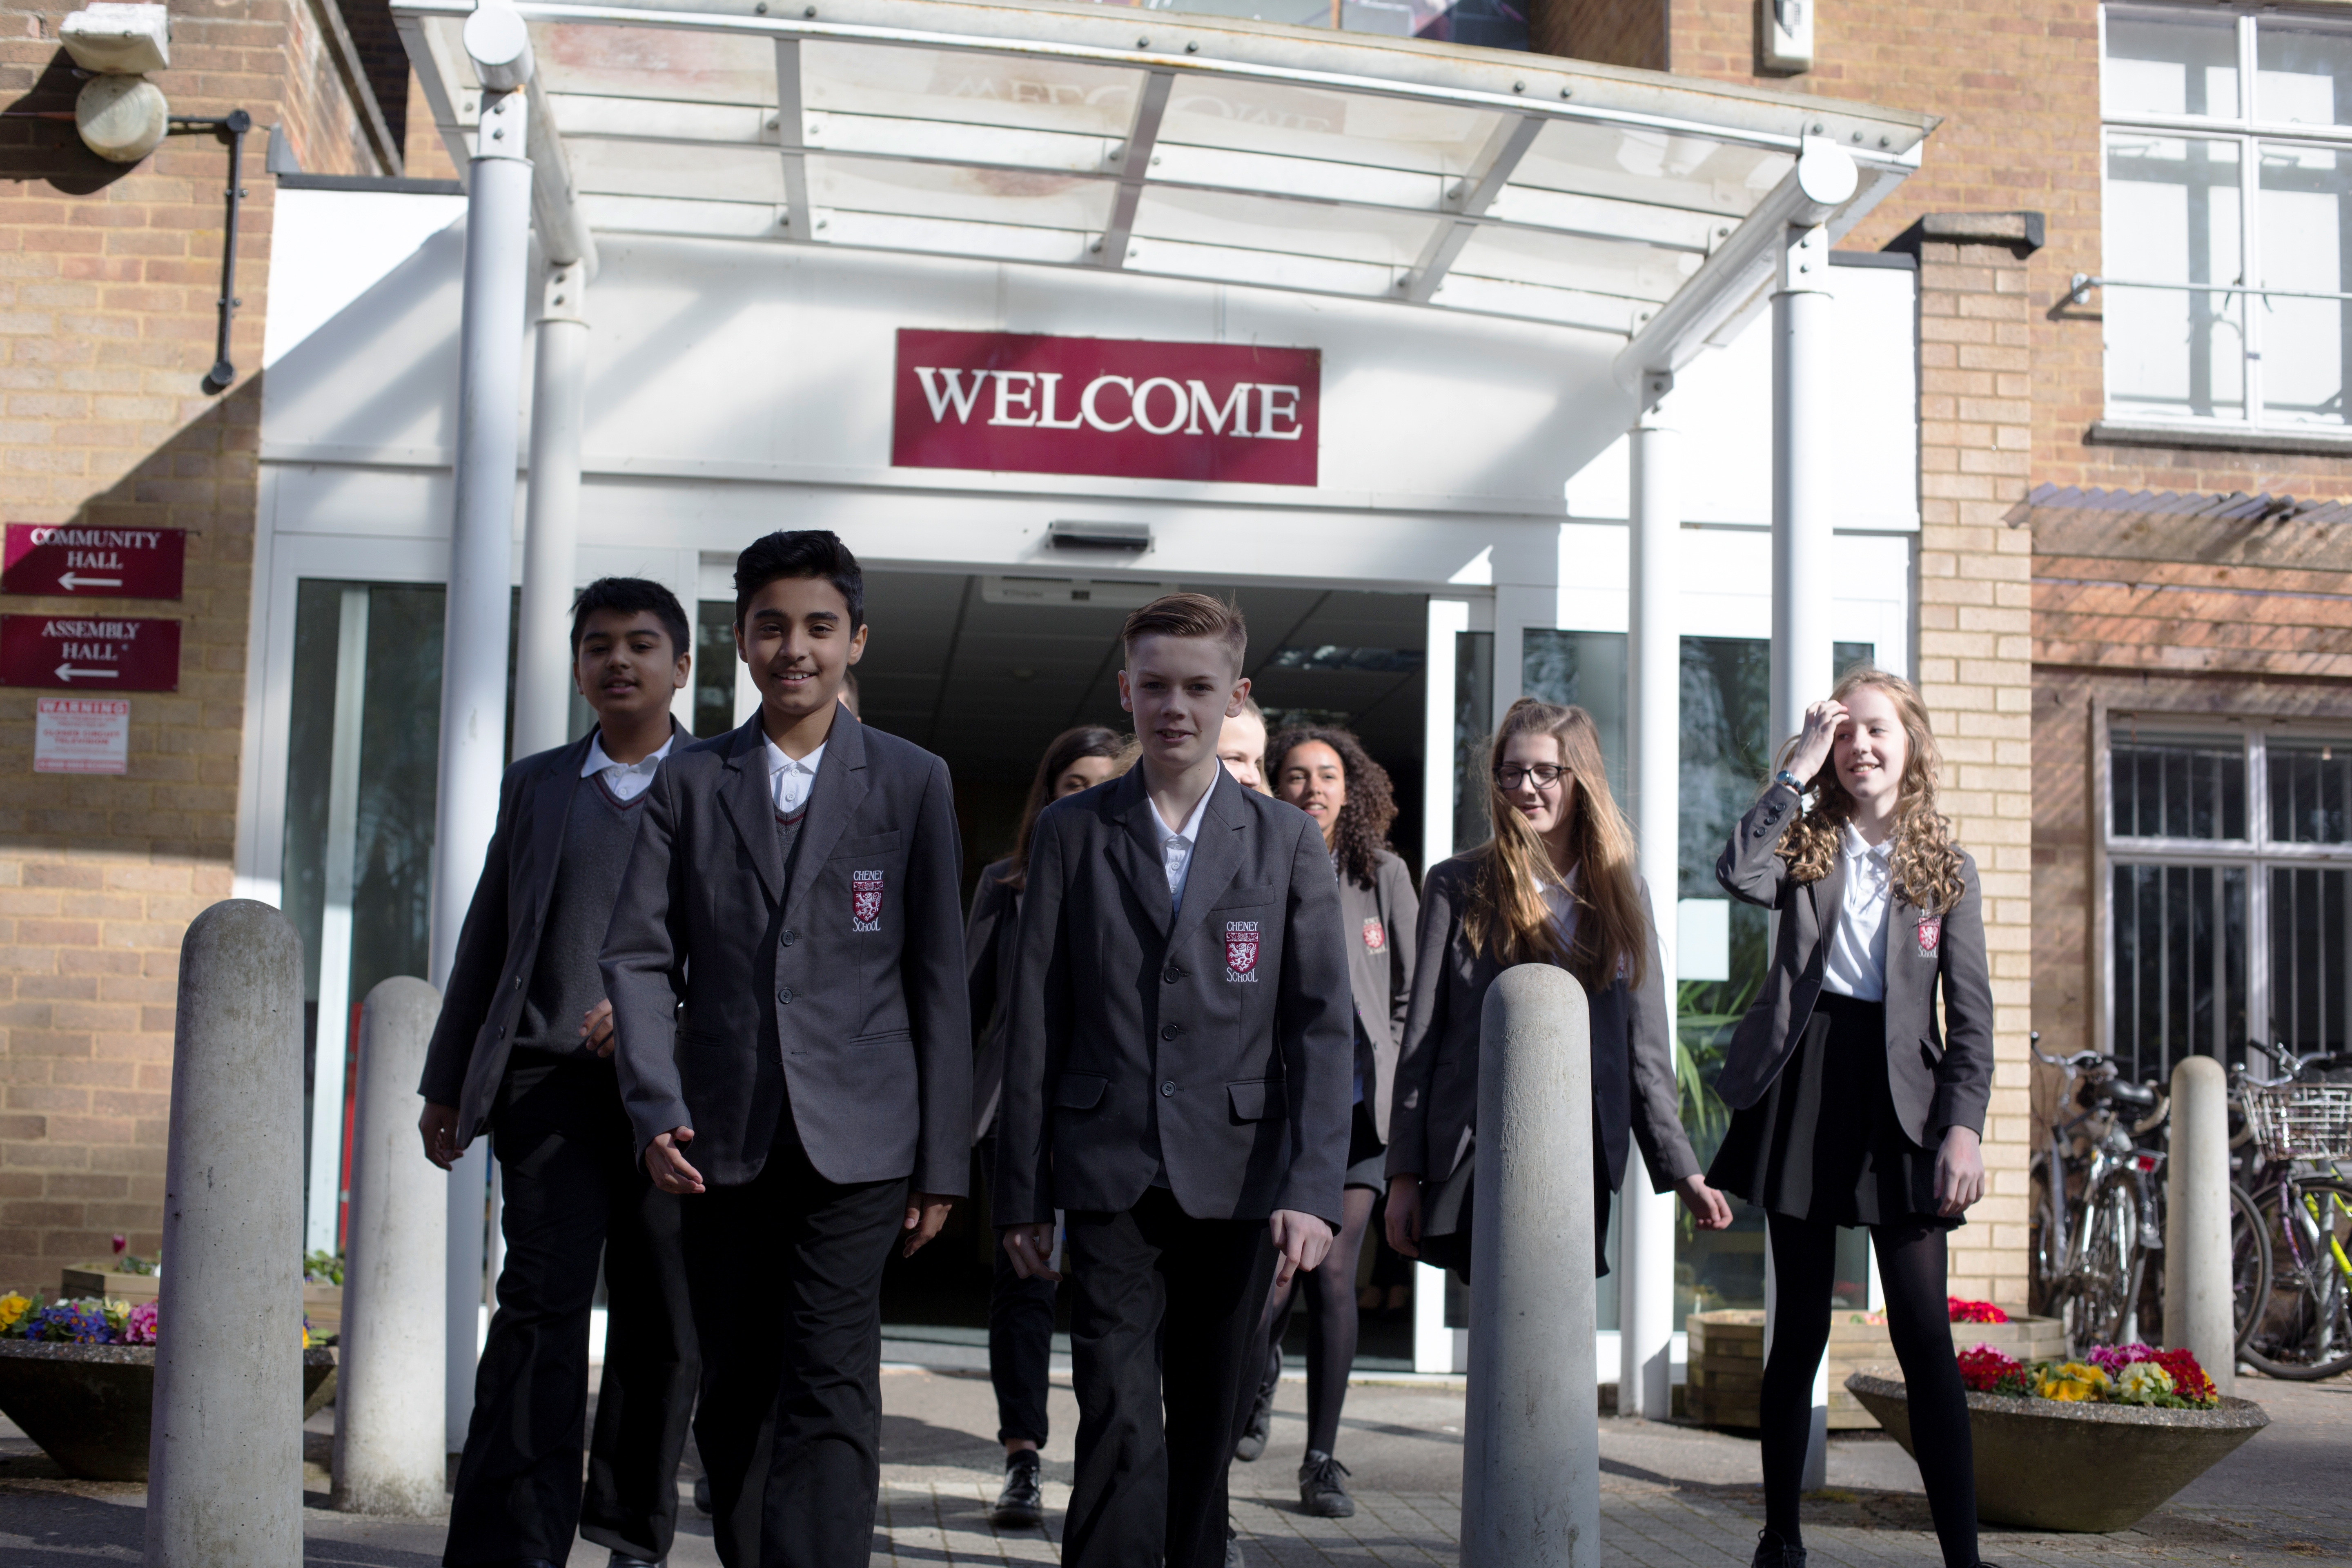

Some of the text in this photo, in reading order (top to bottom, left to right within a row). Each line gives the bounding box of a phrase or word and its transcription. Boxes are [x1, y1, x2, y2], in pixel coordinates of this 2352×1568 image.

[914, 366, 1303, 440] WELCOME
[30, 528, 161, 548] COMMUNITY
[67, 551, 123, 569] HALL
[42, 620, 140, 639] ASSEMBLY
[62, 642, 118, 661] HALL
[42, 702, 125, 714] WARNING
[853, 871, 884, 880] CHENEY
[853, 917, 881, 931] SCHOOL
[1227, 922, 1258, 931] CHENEY
[1227, 967, 1258, 982] SCHOOL
